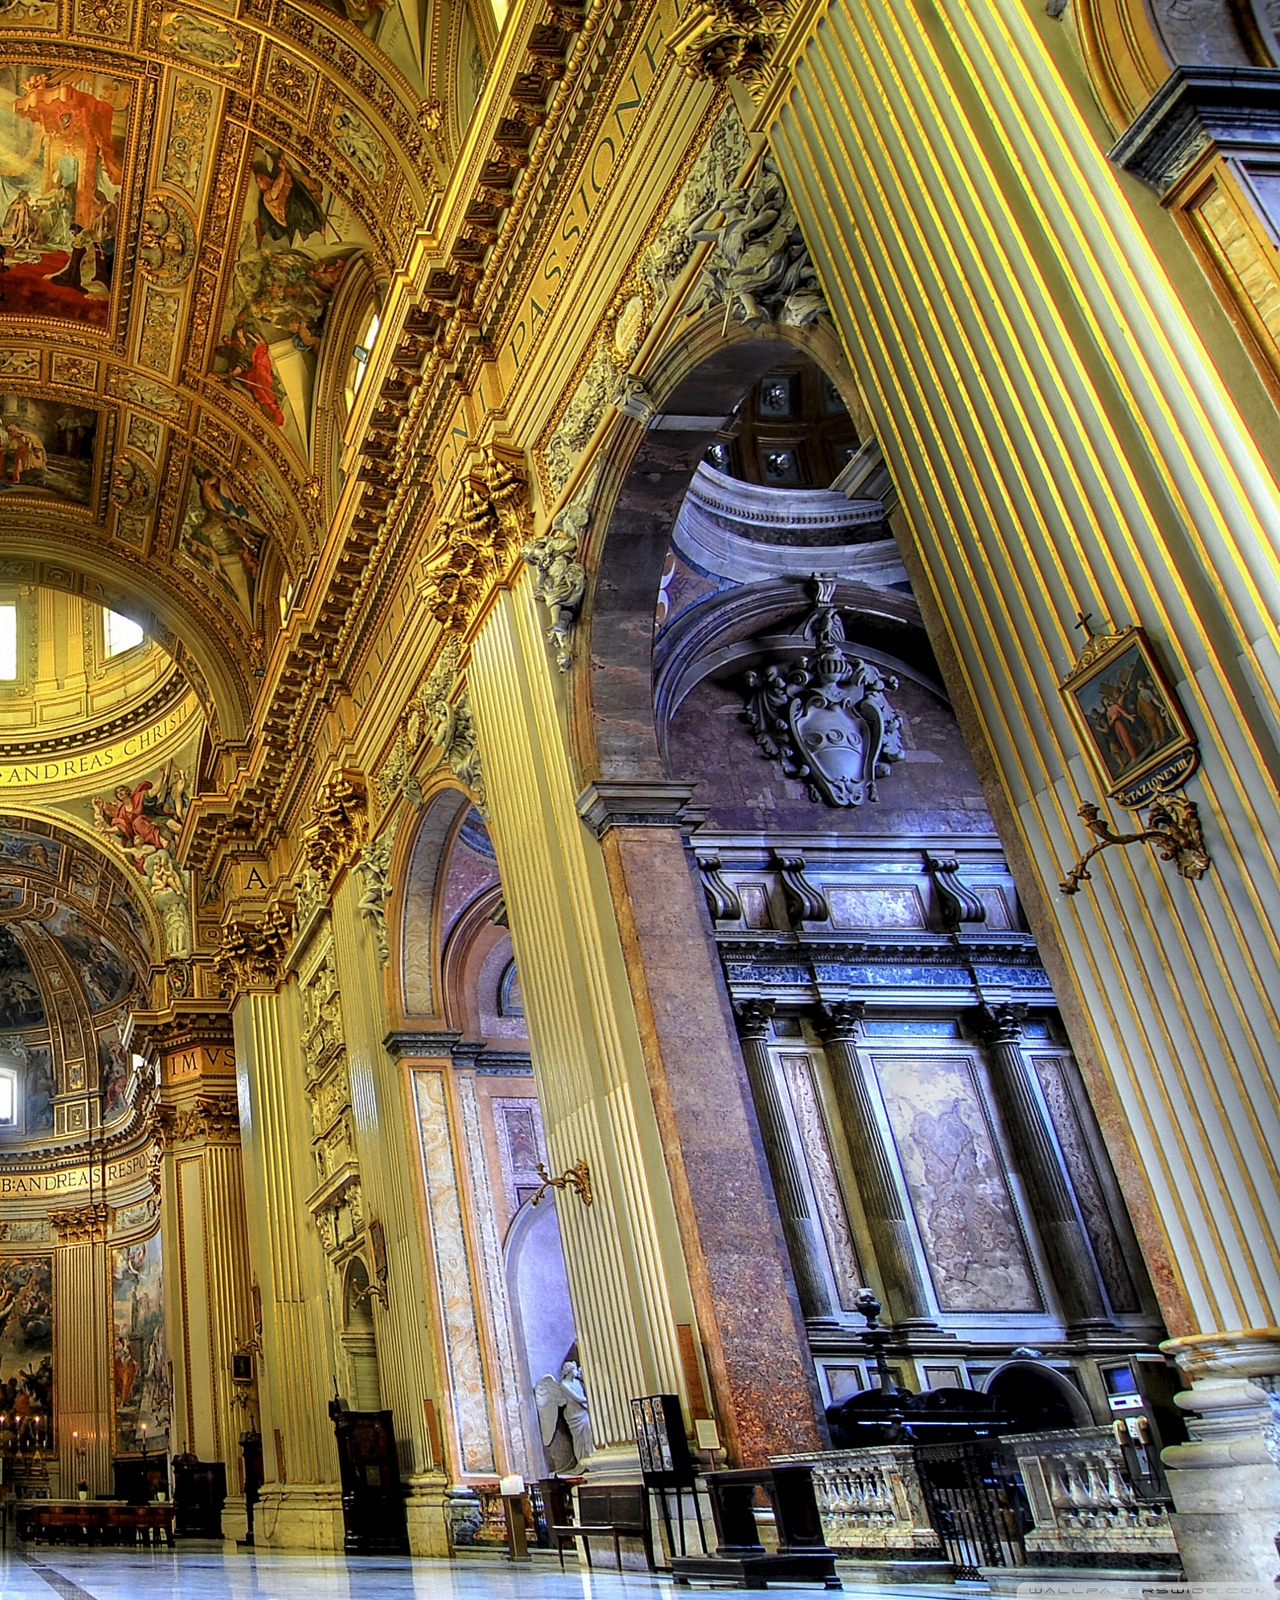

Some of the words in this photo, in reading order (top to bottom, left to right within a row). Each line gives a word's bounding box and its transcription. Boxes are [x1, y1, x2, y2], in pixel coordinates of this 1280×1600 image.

[508, 0, 680, 369] PASSIONE
[8, 748, 114, 783] ANDREAS
[123, 703, 187, 756] CHRISTI
[1123, 768, 1172, 806] STAZIONE
[1169, 758, 1189, 775] VIII
[244, 866, 268, 890] A
[108, 1151, 151, 1181] RESPON
